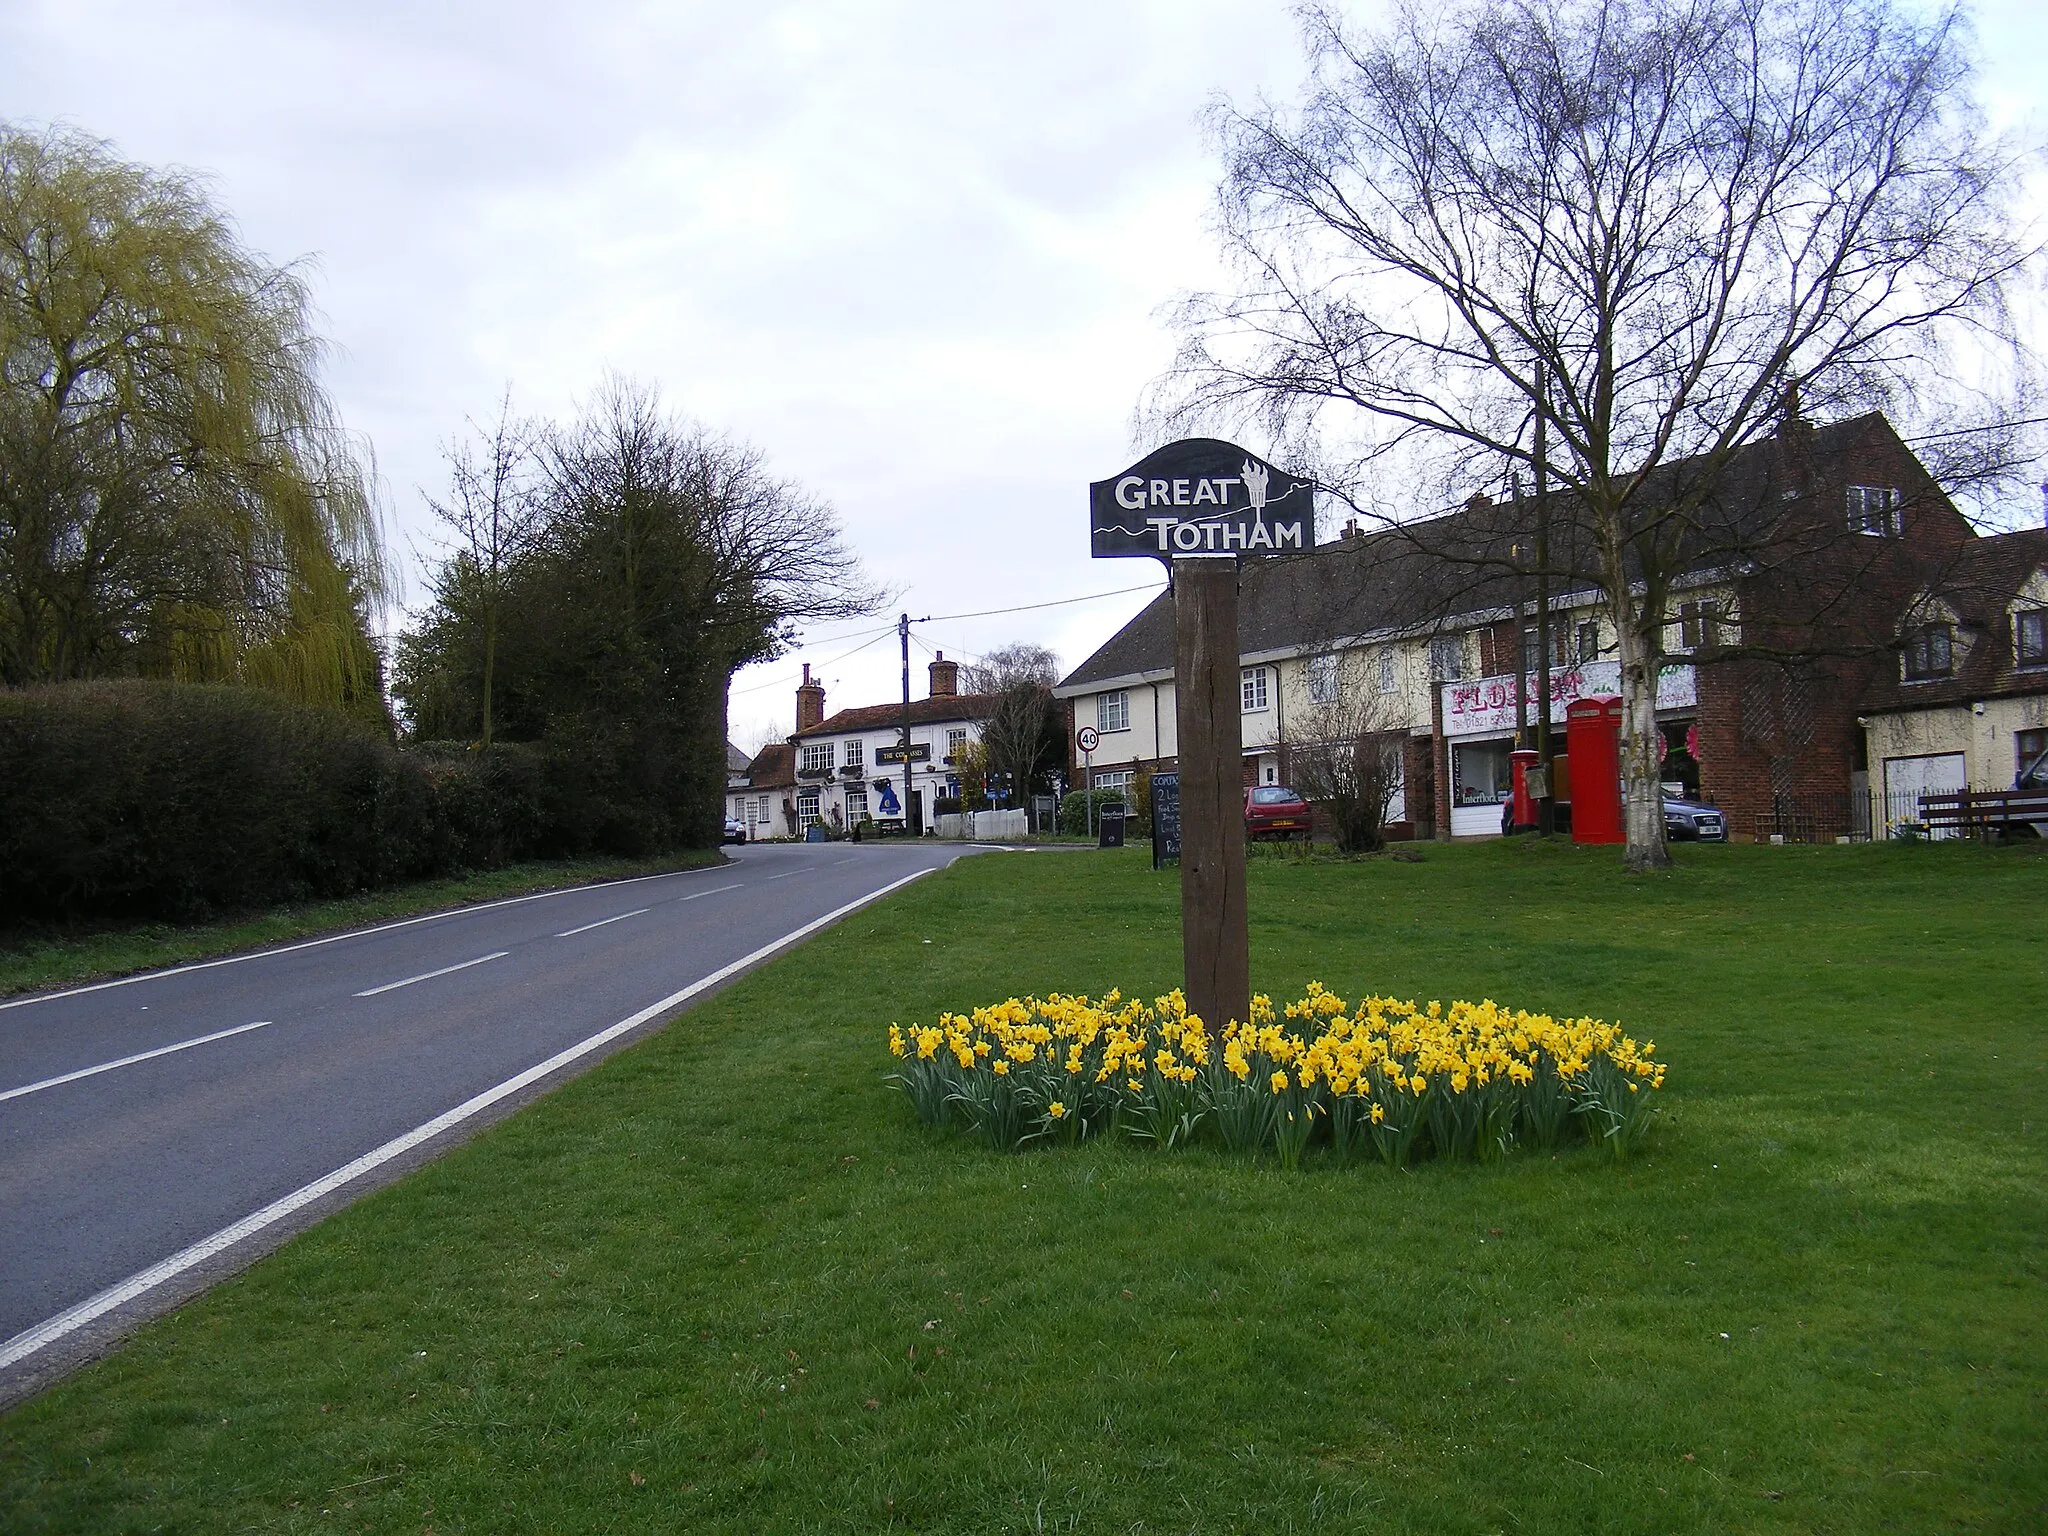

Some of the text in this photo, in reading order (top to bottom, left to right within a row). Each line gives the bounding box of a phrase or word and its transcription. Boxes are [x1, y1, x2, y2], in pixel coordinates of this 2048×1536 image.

[1115, 476, 1241, 510] GREAT
[1146, 517, 1302, 551] TOTHAM
[1082, 734, 1096, 744] 40
[1157, 788, 1165, 801] 2
